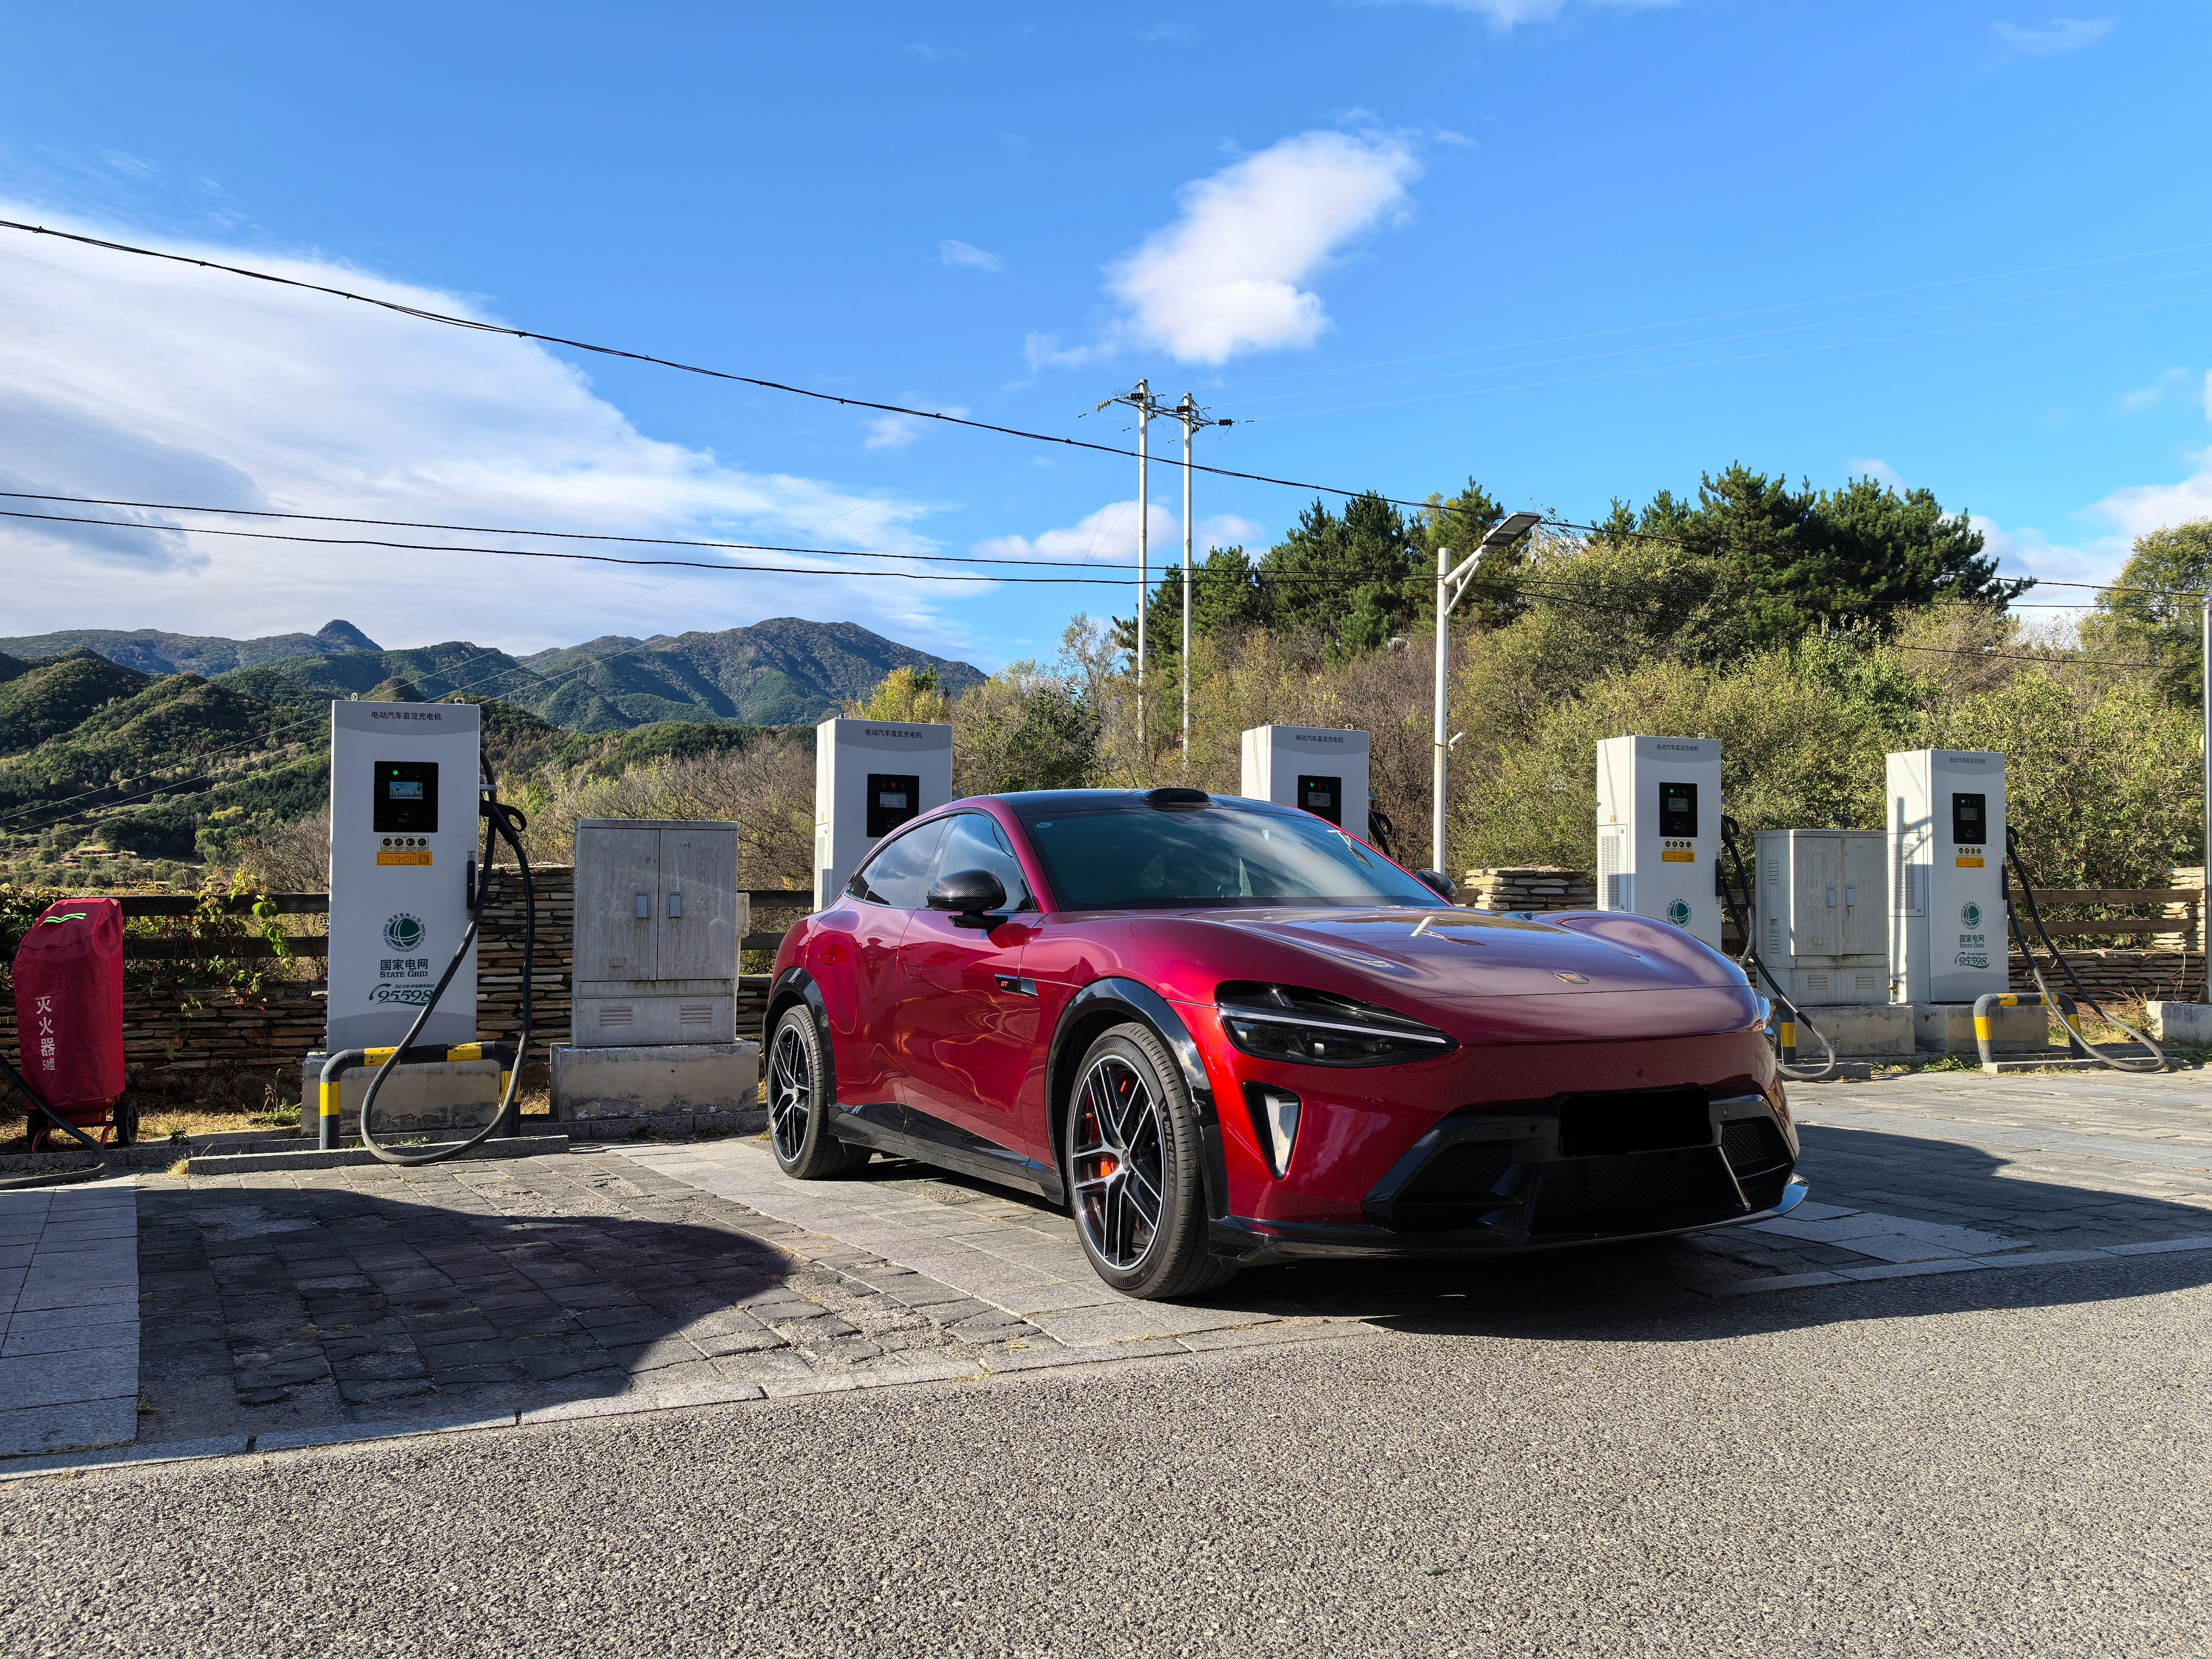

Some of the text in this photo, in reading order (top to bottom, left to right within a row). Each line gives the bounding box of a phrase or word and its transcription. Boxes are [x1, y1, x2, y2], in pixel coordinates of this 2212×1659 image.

[371, 711, 442, 720] 电动汽车直流充电机
[865, 729, 922, 738] 电动汽车直流充电机
[1296, 734, 1344, 743] 电动汽车直流充电机
[1959, 934, 1984, 943] 国家电网
[380, 958, 428, 970] 国家电网
[1959, 957, 1987, 966] 95598
[377, 989, 434, 1002] 95598
[35, 995, 56, 1057] 灭火器
[42, 1057, 56, 1070] 50型
[1164, 1121, 1175, 1199] MICHELIN
